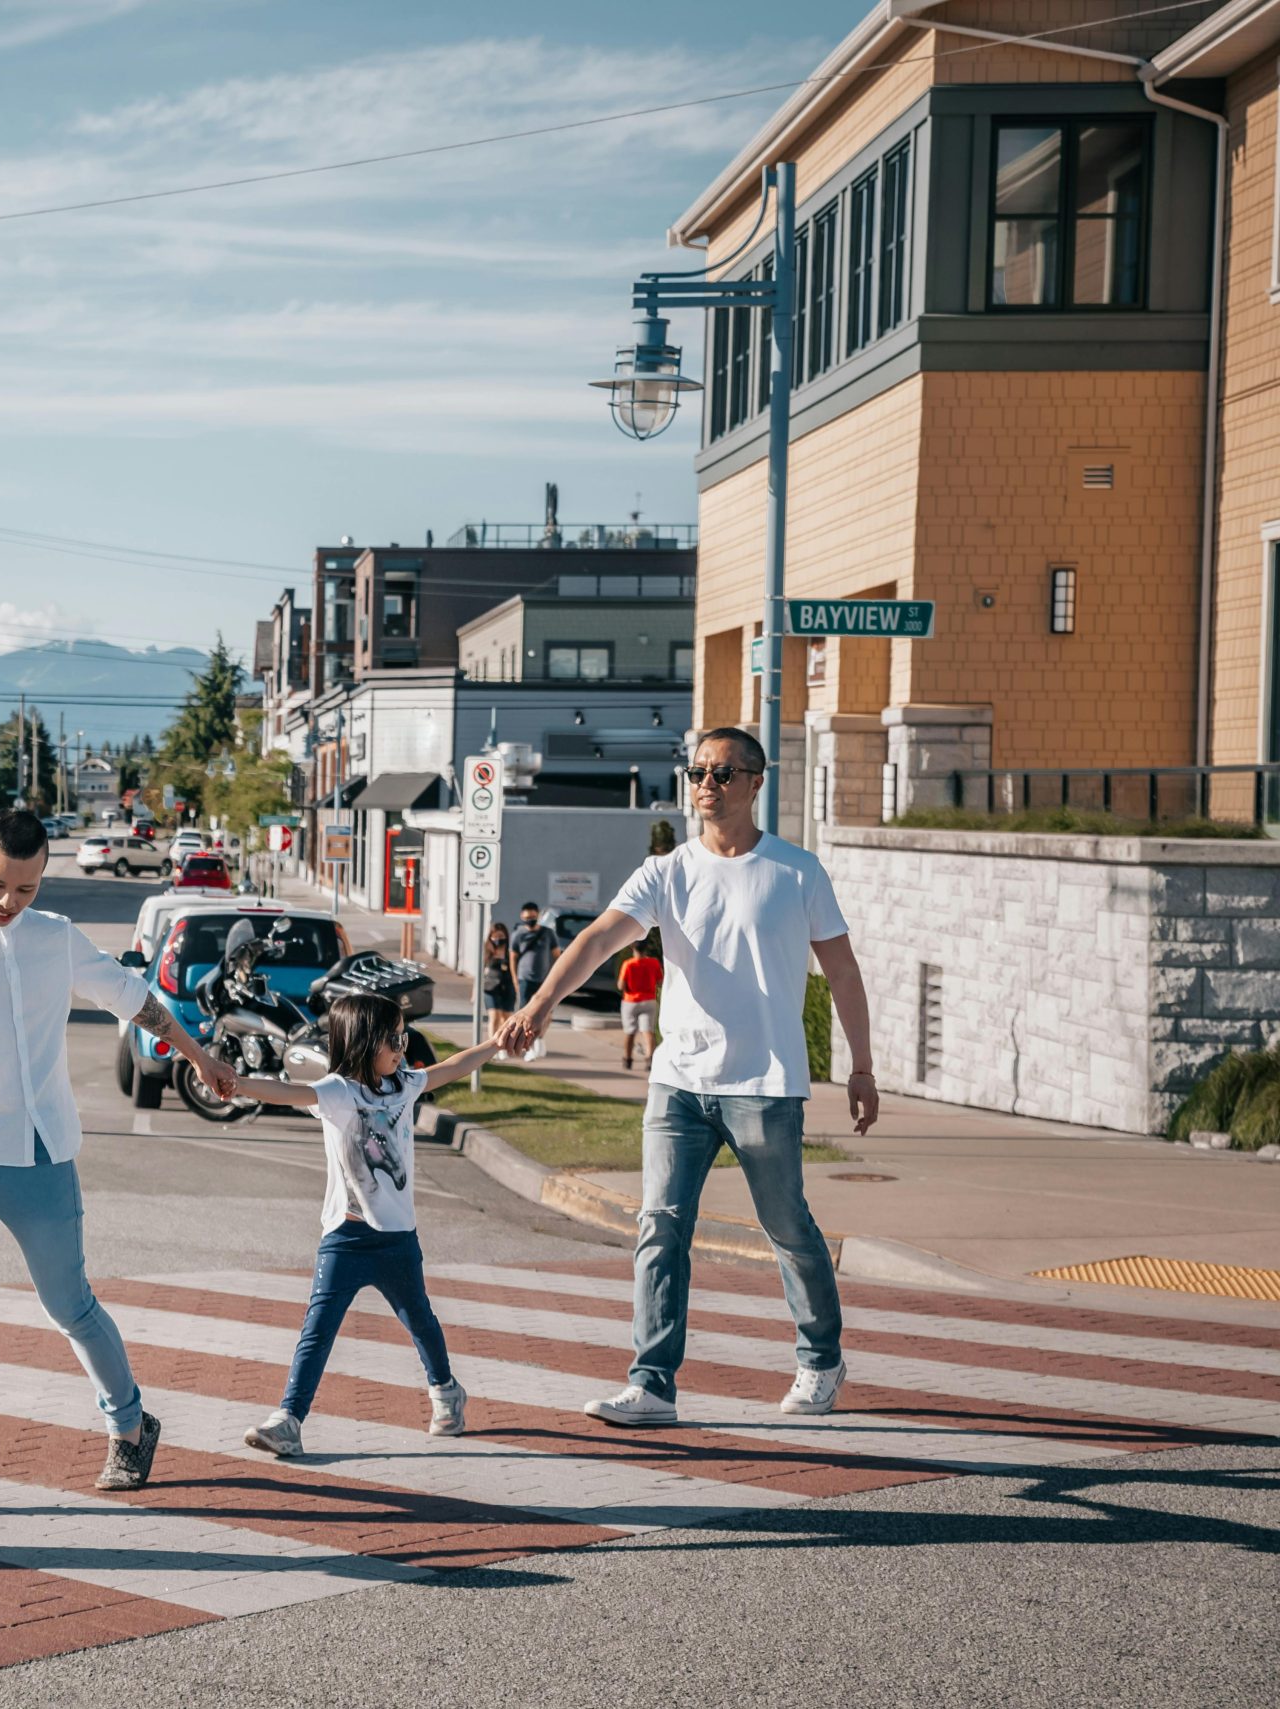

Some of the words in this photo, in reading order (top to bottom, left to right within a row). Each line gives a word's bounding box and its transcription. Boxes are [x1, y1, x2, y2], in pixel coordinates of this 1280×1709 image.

[800, 605, 900, 631] BAYVIEW
[908, 606, 919, 618] ST
[476, 850, 486, 865] P
